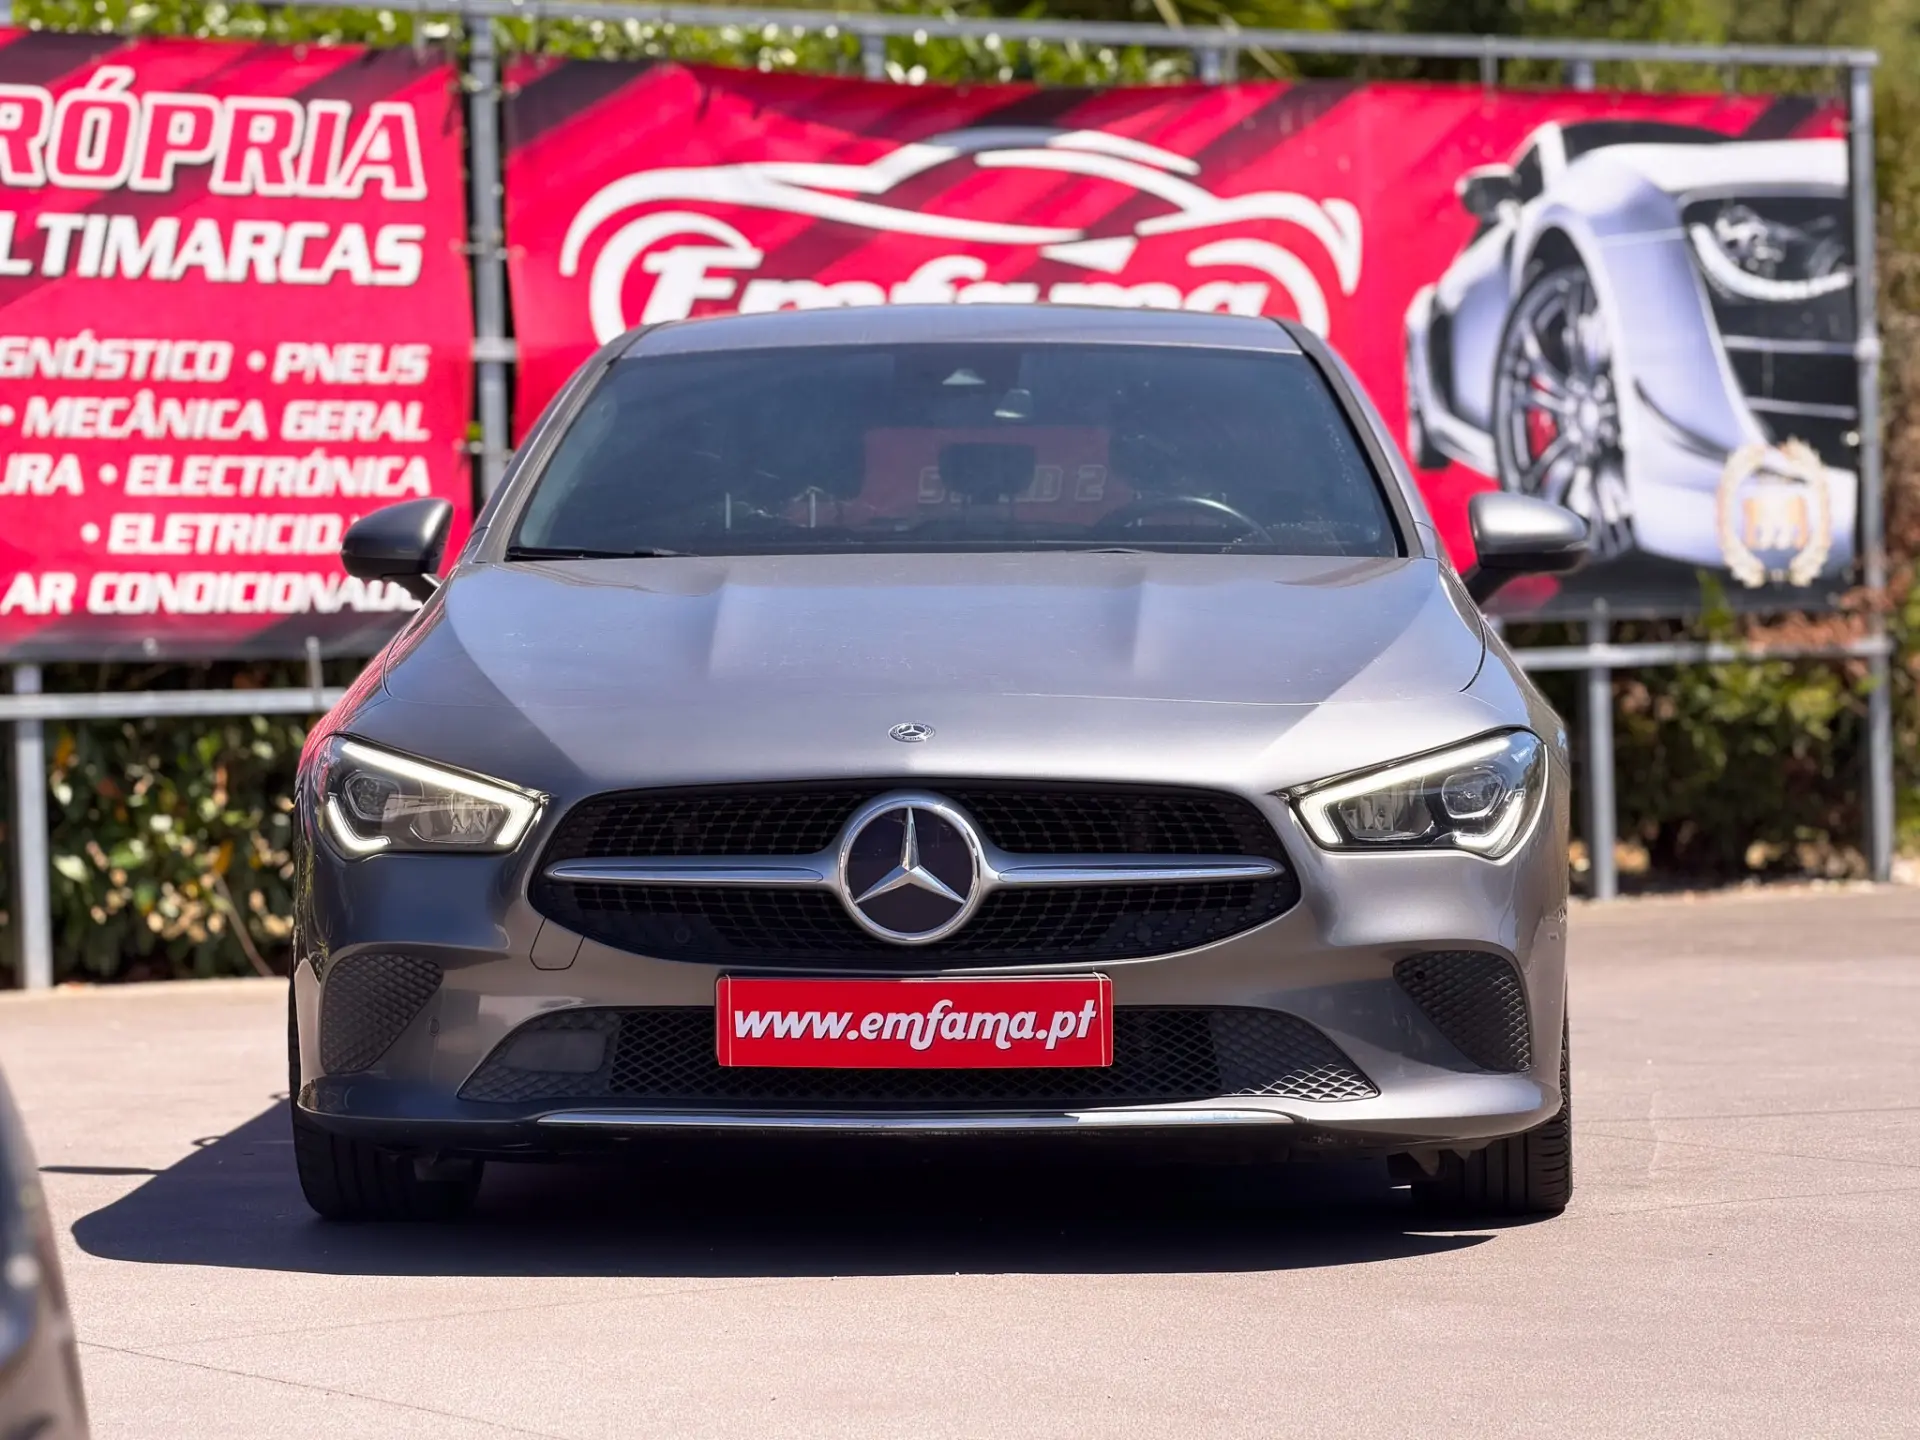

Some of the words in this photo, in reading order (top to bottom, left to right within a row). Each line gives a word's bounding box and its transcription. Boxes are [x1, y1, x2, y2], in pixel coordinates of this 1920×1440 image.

[0, 212, 424, 285] LTIMARCAS
[0, 330, 232, 381] GNÓSTICO
[272, 343, 429, 384] PNEUS
[22, 389, 267, 439] MECÂNICA
[281, 400, 429, 441] GERAL
[124, 448, 430, 497] ELECTRÓNICA
[107, 512, 345, 555] ELETRICID
[0, 572, 76, 615] AR
[734, 999, 1097, 1050] www.emfama.pt
